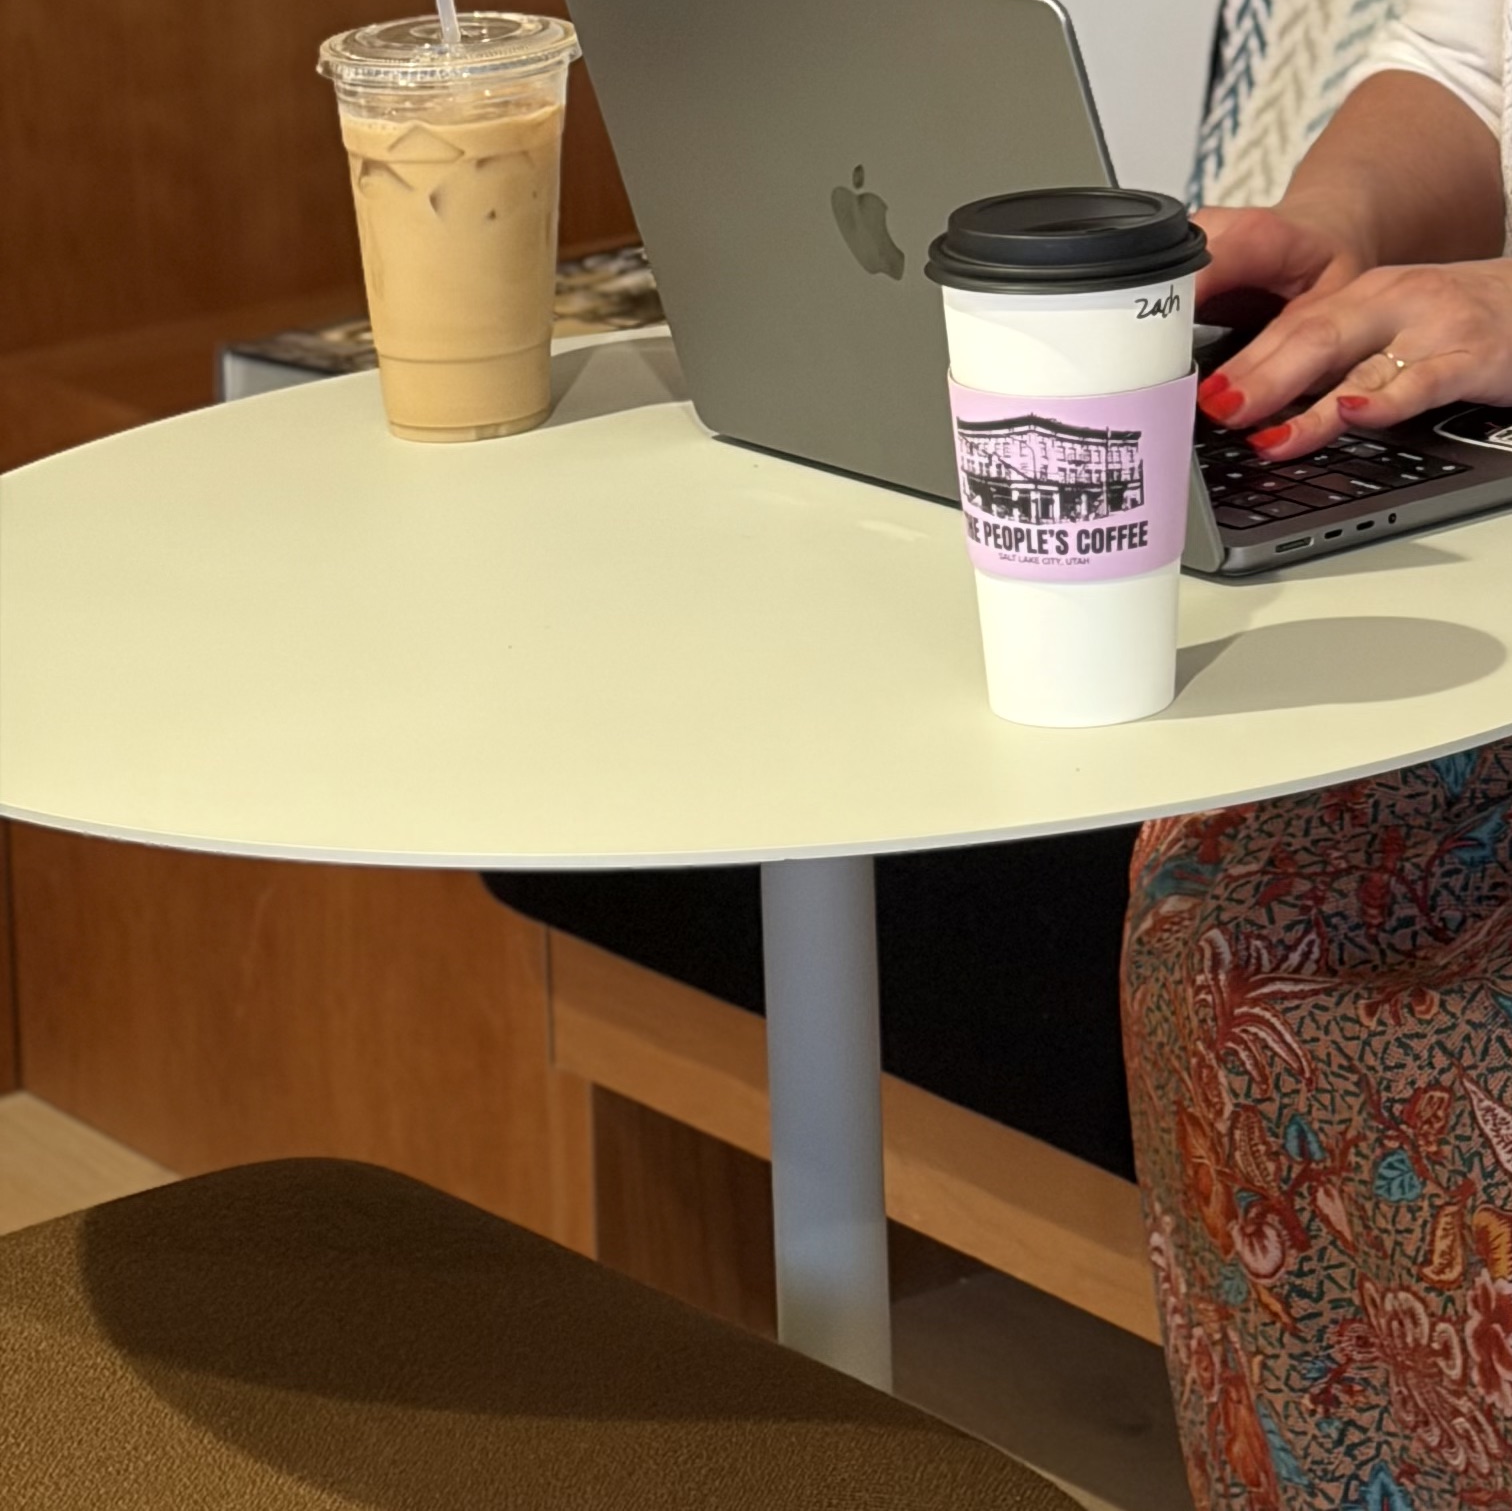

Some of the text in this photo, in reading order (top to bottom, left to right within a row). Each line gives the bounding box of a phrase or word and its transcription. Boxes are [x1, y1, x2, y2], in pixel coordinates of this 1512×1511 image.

[983, 520, 1069, 555] PEOPLE'S
[1076, 520, 1148, 555] COFFEE
[998, 553, 1016, 562] SALT
[1018, 555, 1040, 565] LAKE
[1065, 557, 1090, 566] UTAH
